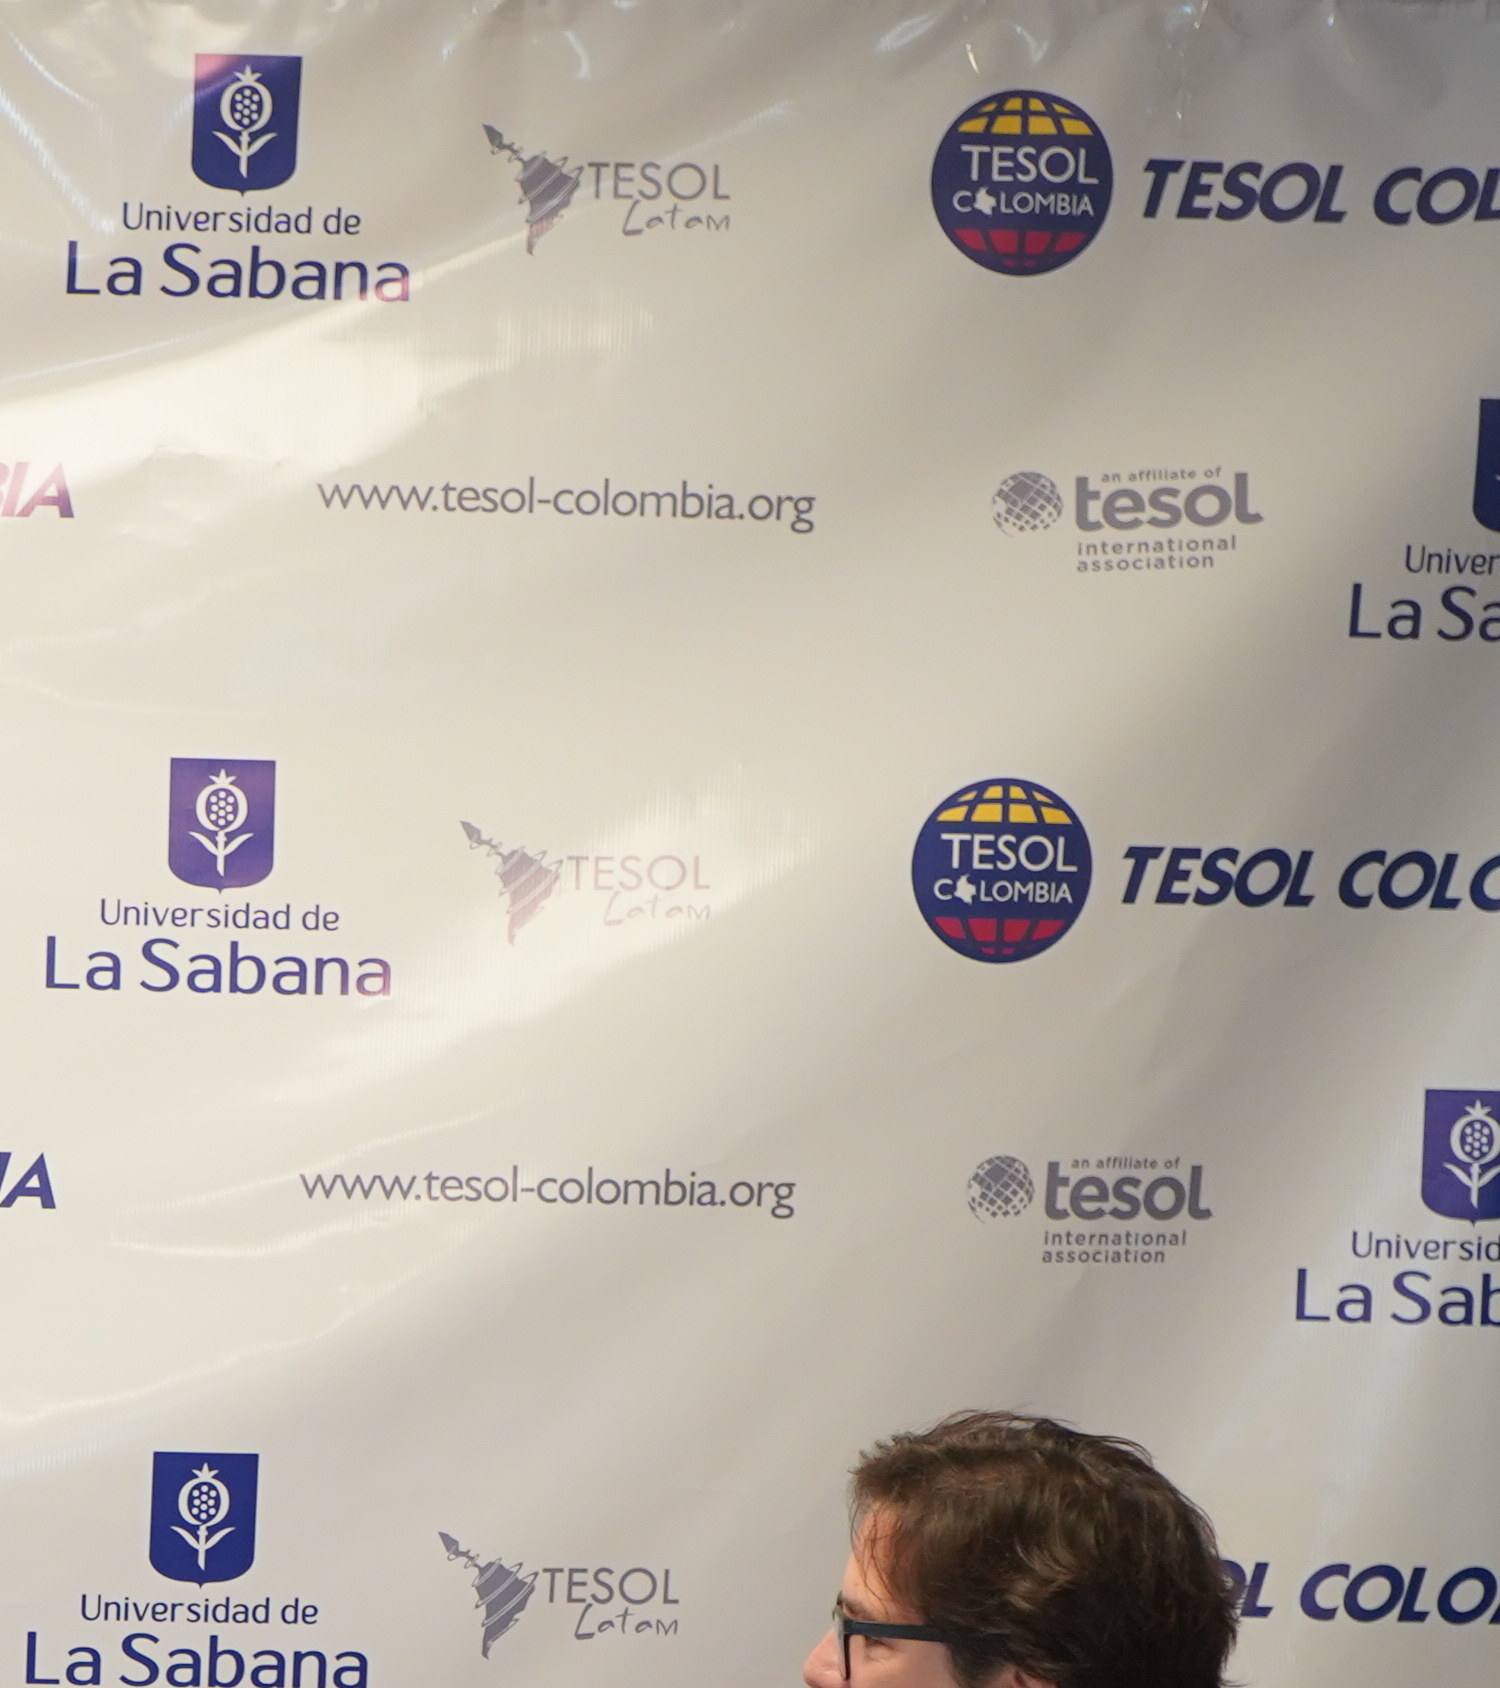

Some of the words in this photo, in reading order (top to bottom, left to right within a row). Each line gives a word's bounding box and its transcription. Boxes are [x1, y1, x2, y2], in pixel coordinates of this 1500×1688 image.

[586, 160, 731, 202] TESOL
[960, 144, 1100, 185] TESOL
[1142, 158, 1348, 224] TESOL
[122, 201, 313, 235] Universidad
[322, 206, 362, 236] de
[621, 199, 731, 237] Latam
[65, 240, 143, 297] La
[159, 242, 410, 302] Sabana
[1100, 472, 1122, 484] an
[1127, 468, 1197, 483] affiliate
[1202, 465, 1222, 479] of
[317, 475, 817, 535] www.tesol-colombia.org
[1074, 468, 1265, 533] tesol
[1076, 554, 1215, 573] association
[1077, 533, 1237, 557] international
[1348, 582, 1422, 641] La
[940, 832, 1078, 872] TESOL
[567, 854, 711, 891] TESOL
[1121, 845, 1315, 908] TESOL
[100, 898, 291, 931] Universidad
[301, 903, 340, 932] de
[45, 935, 122, 991] La
[139, 937, 391, 996] Sabana
[1070, 1158, 1091, 1170] an
[1095, 1155, 1159, 1170] affiliate
[1163, 1155, 1181, 1170] of
[299, 1164, 797, 1221] www.tesol-colombia.org
[1044, 1159, 1213, 1222] tesol
[1041, 1247, 1166, 1264] association
[1044, 1229, 1187, 1247] international
[1295, 1267, 1373, 1324] La
[541, 1566, 680, 1606] TESOL
[80, 1593, 271, 1625] Universidad
[280, 1597, 319, 1625] de
[573, 1602, 679, 1641] Latam
[25, 1631, 102, 1687] La
